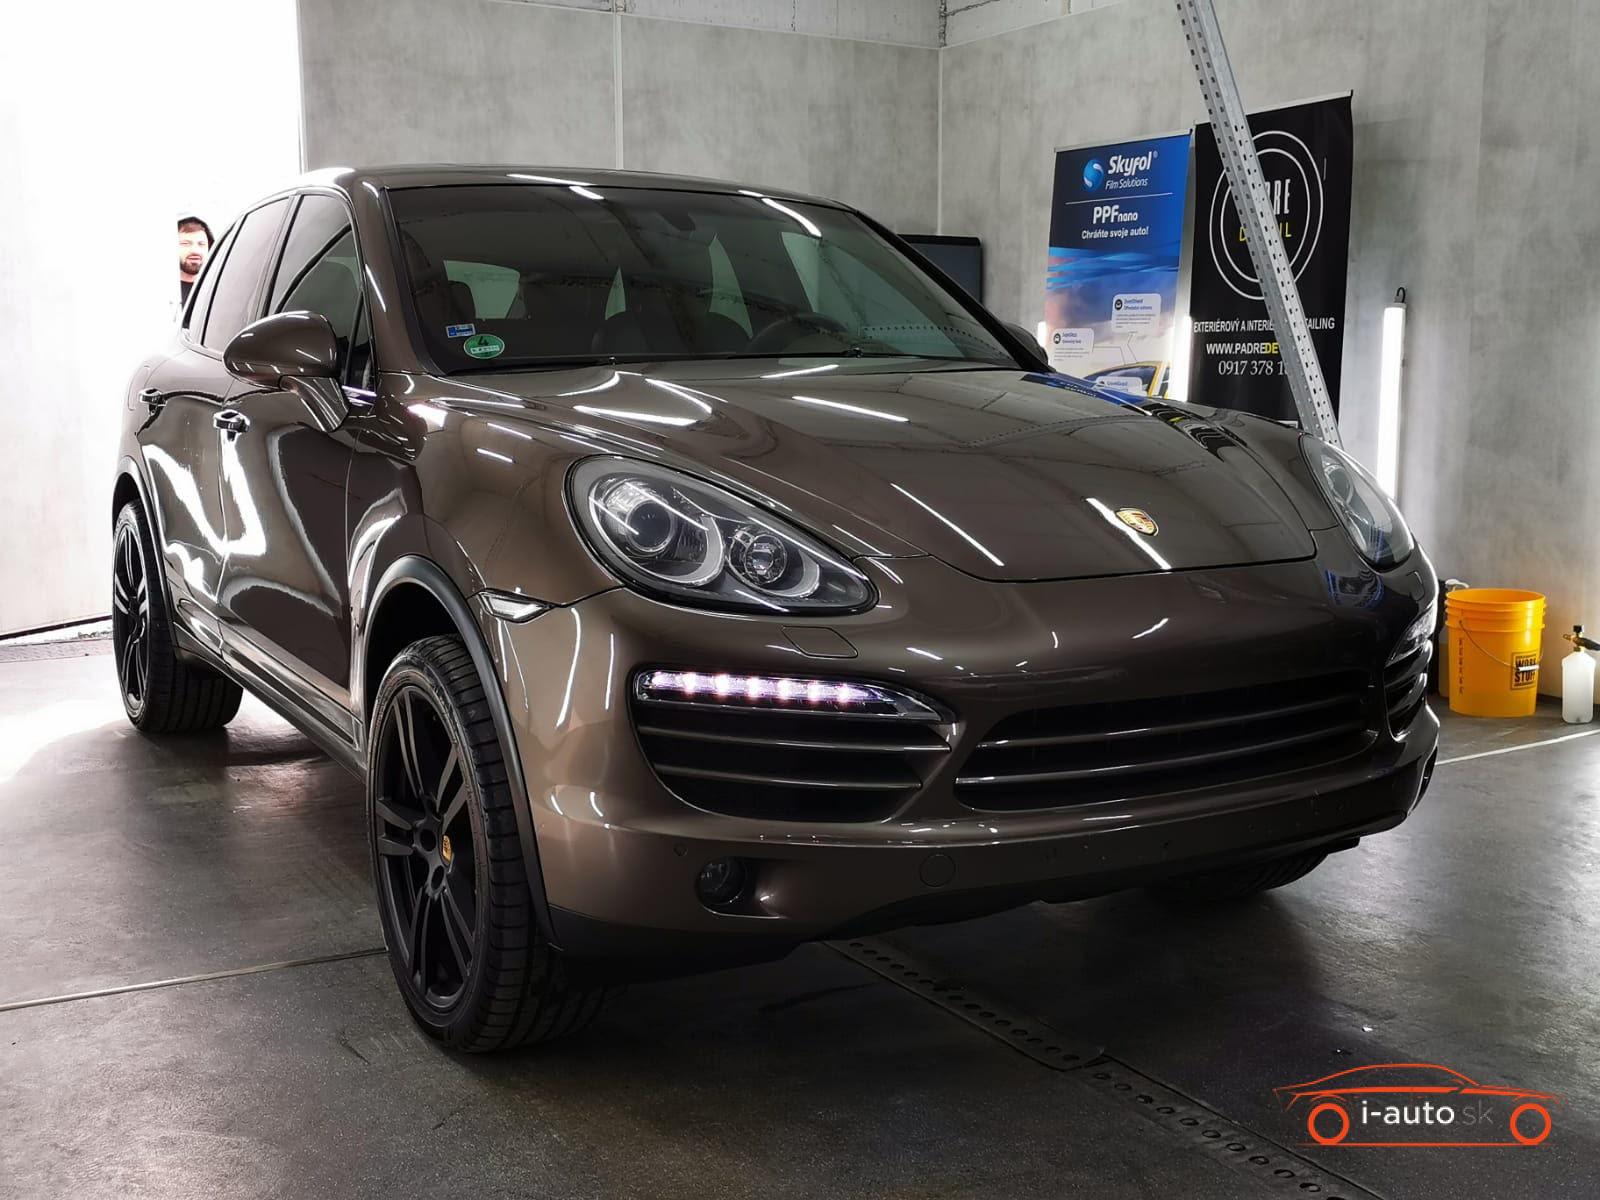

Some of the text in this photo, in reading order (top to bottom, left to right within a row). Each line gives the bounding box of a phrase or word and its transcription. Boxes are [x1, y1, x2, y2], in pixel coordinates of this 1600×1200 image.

[1105, 177, 1149, 190] Film Solutions
[1109, 227, 1129, 239] svoje
[1129, 226, 1150, 236] auto!
[1193, 318, 1240, 333] EXTERIÉROVÝ
[1240, 321, 1246, 331] A
[1218, 360, 1248, 375] 0917
[1250, 360, 1274, 376] 378
